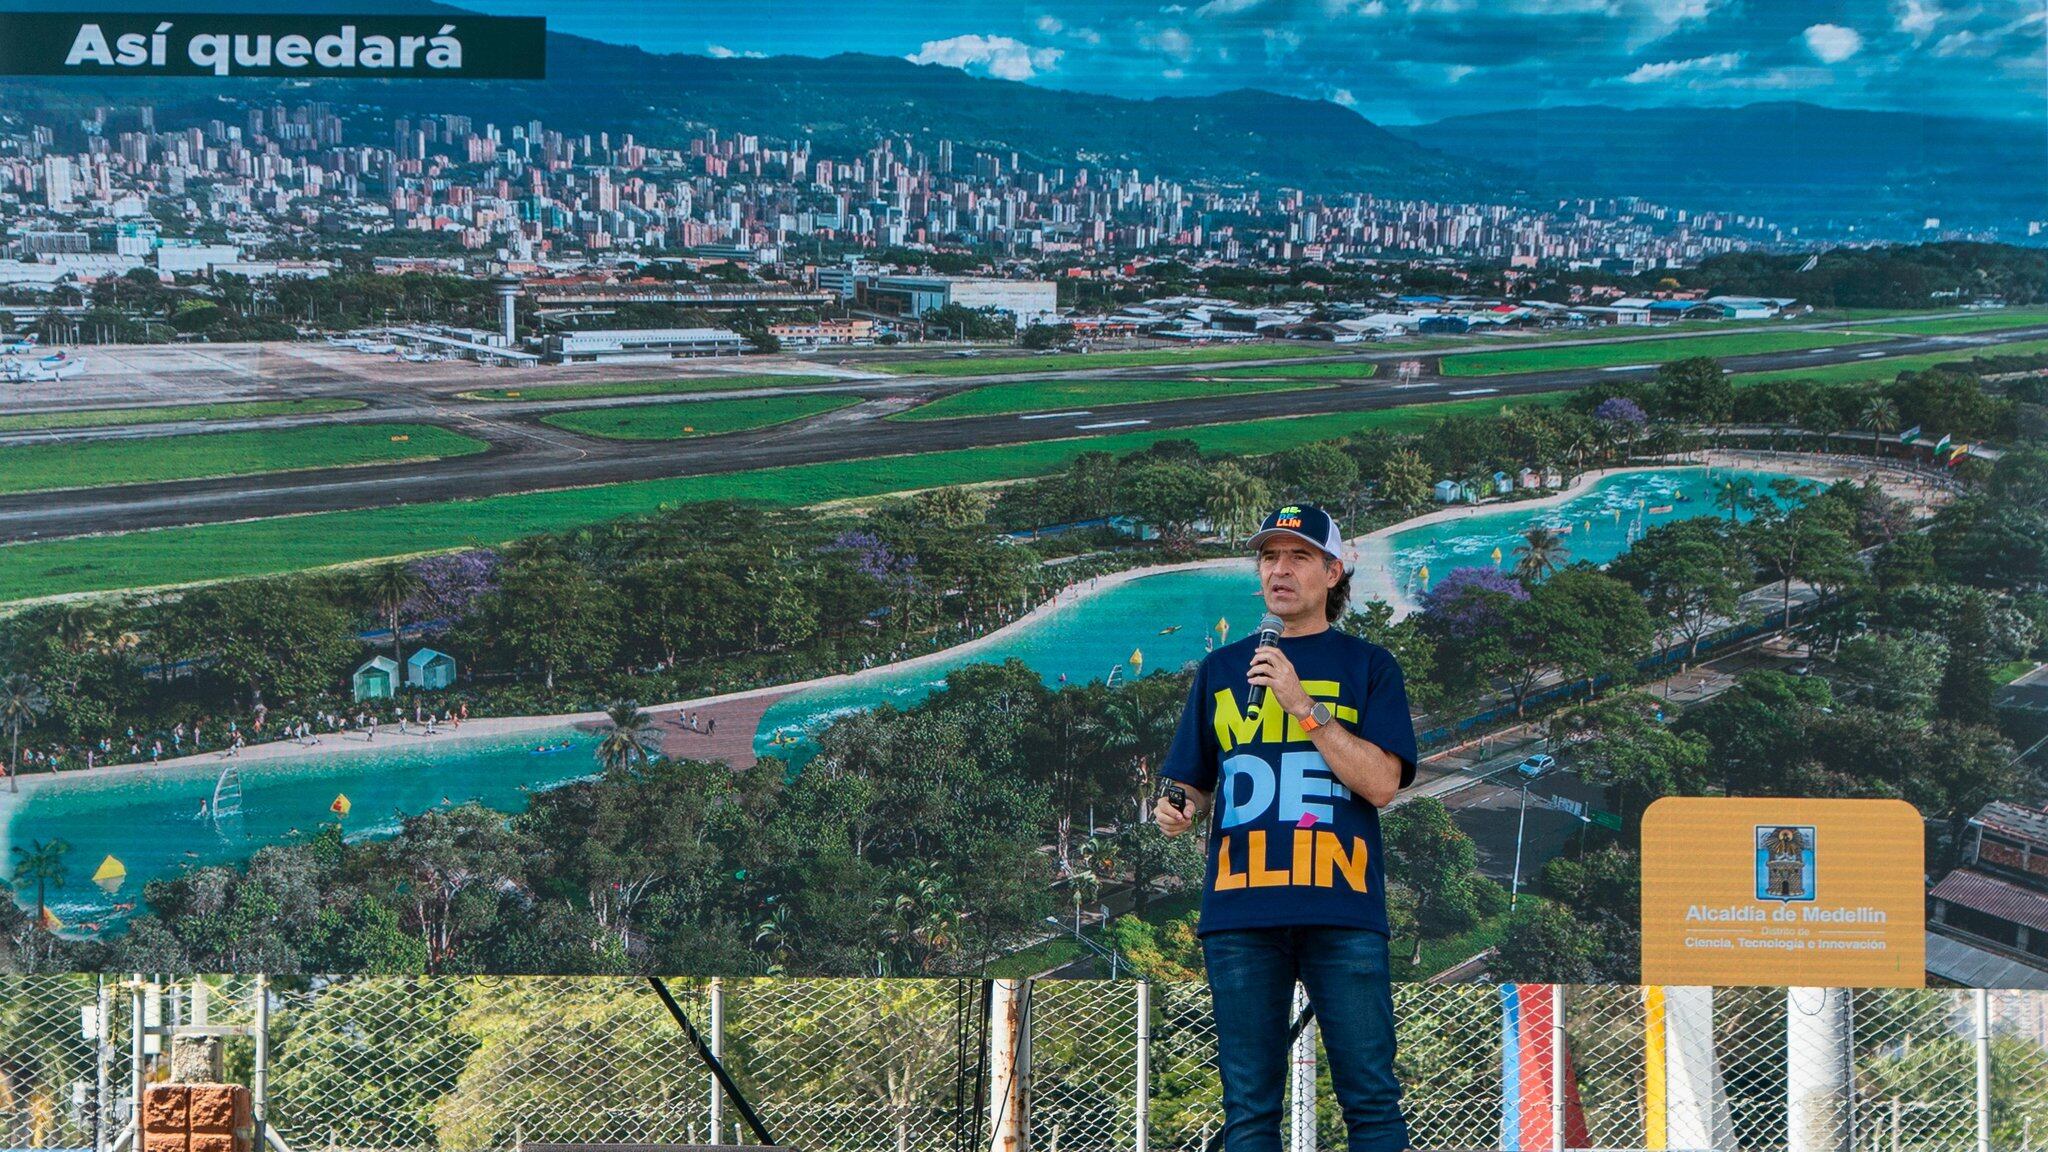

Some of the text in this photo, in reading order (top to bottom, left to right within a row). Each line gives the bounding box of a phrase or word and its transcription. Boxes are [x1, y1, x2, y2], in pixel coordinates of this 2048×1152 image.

[64, 21, 463, 76] Así quedará
[1686, 904, 1887, 923] Alcaldía de Medellín
[1685, 937, 1735, 949] Ciencia,
[1808, 941, 1816, 949] e
